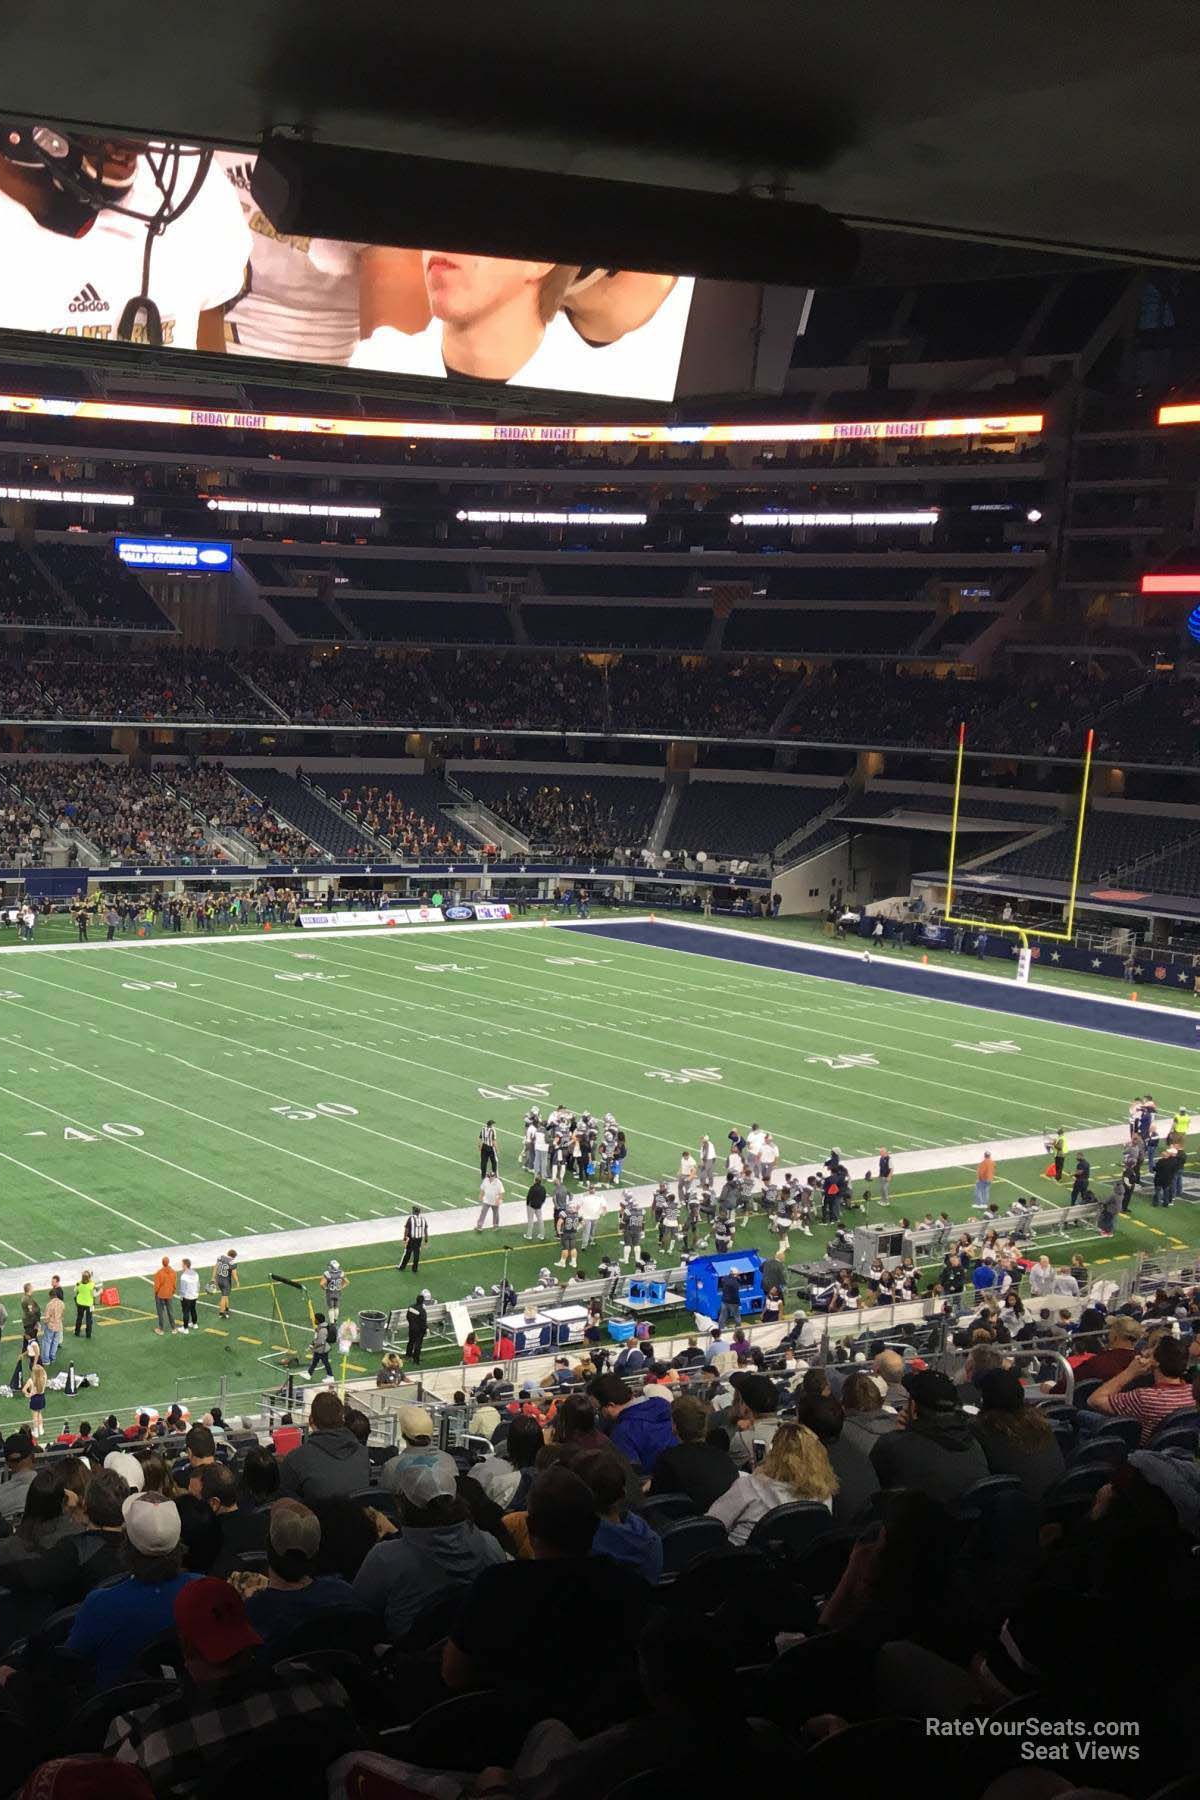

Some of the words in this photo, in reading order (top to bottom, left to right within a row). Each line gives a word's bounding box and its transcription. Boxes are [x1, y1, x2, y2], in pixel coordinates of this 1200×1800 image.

[190, 411, 229, 427] FRIDAY
[233, 414, 267, 429] NIGHT
[494, 427, 535, 441] FRIDAY
[540, 428, 577, 442] NIGHT
[833, 423, 880, 438] FRIDAY
[885, 421, 927, 436] NIGHT
[477, 1083, 551, 1102] 40
[269, 1102, 360, 1121] 50
[63, 1122, 145, 1143] 40
